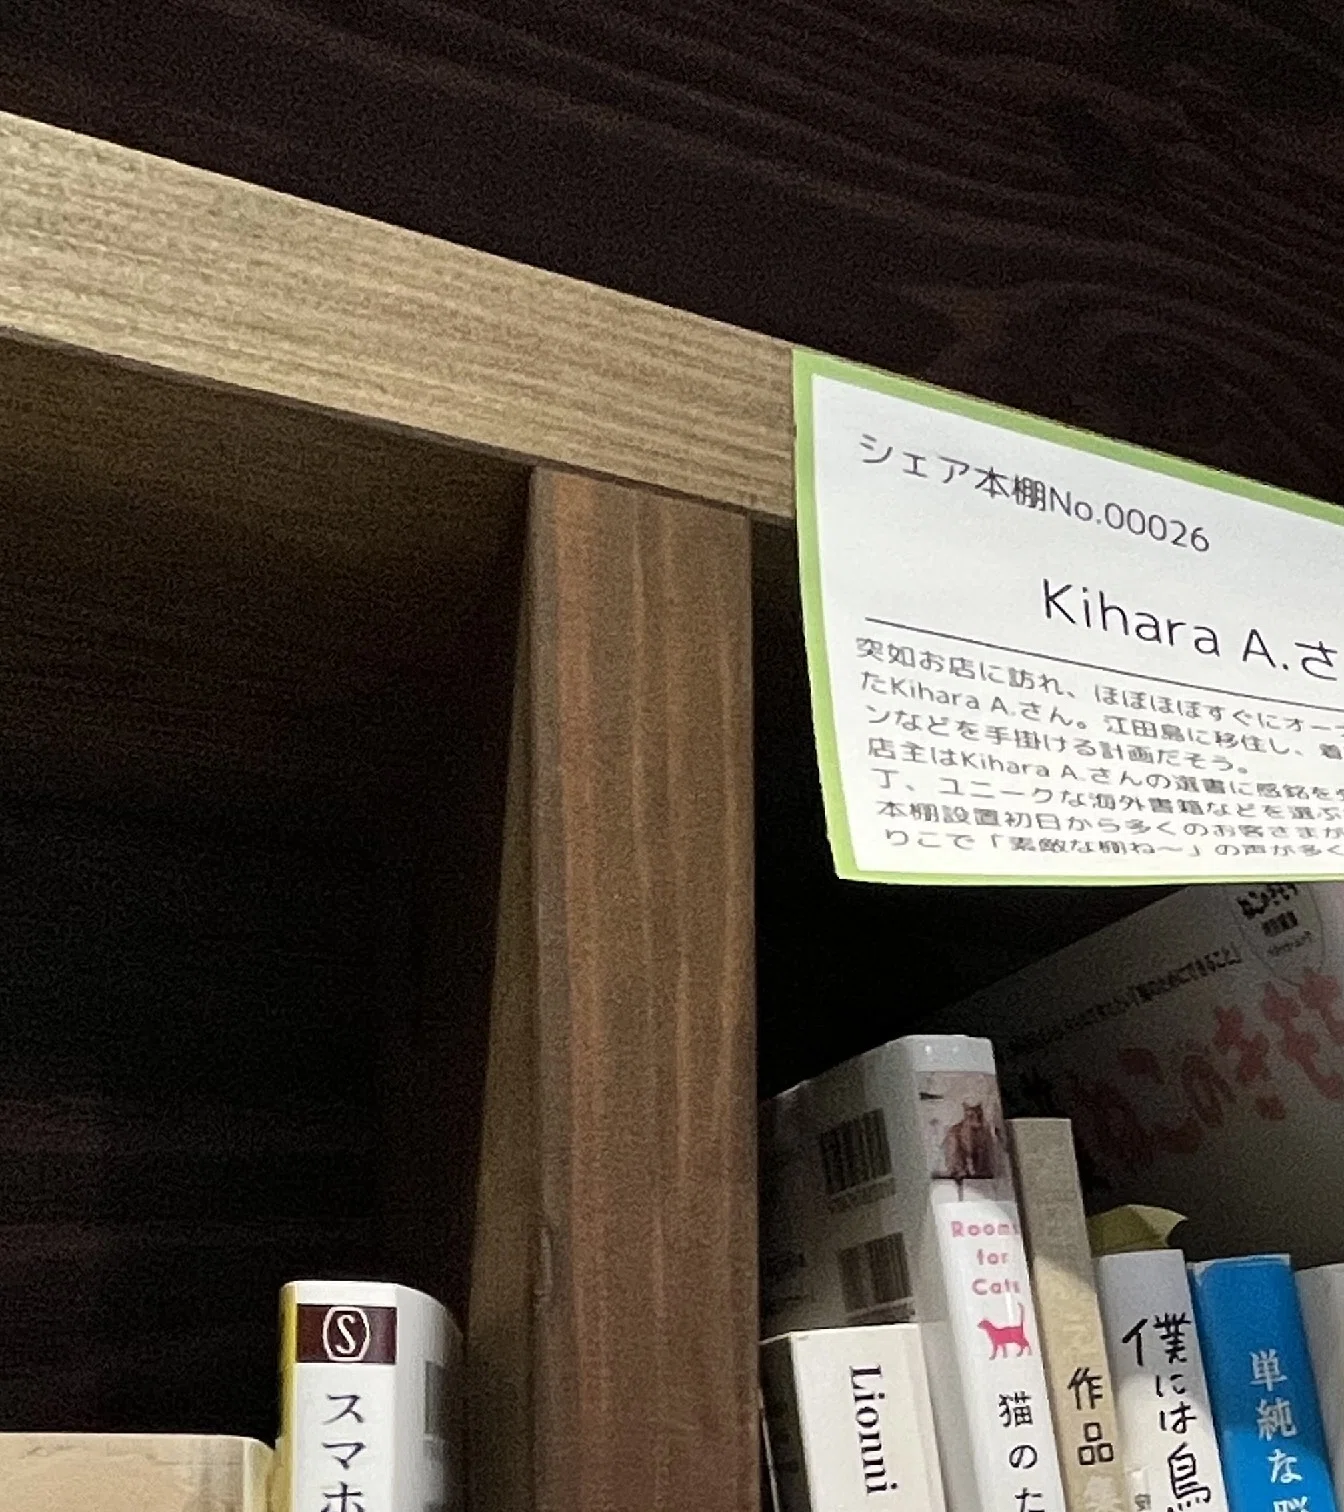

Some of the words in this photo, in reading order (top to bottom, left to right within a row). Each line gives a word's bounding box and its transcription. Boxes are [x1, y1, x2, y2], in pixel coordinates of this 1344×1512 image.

[858, 433, 1210, 554] シェア本棚No.00026
[1040, 580, 1219, 658] Kihara
[950, 1218, 1020, 1241] Rooms
[975, 1247, 1011, 1268] for
[971, 1276, 1021, 1297] Cats
[849, 1364, 898, 1495] Lionni
